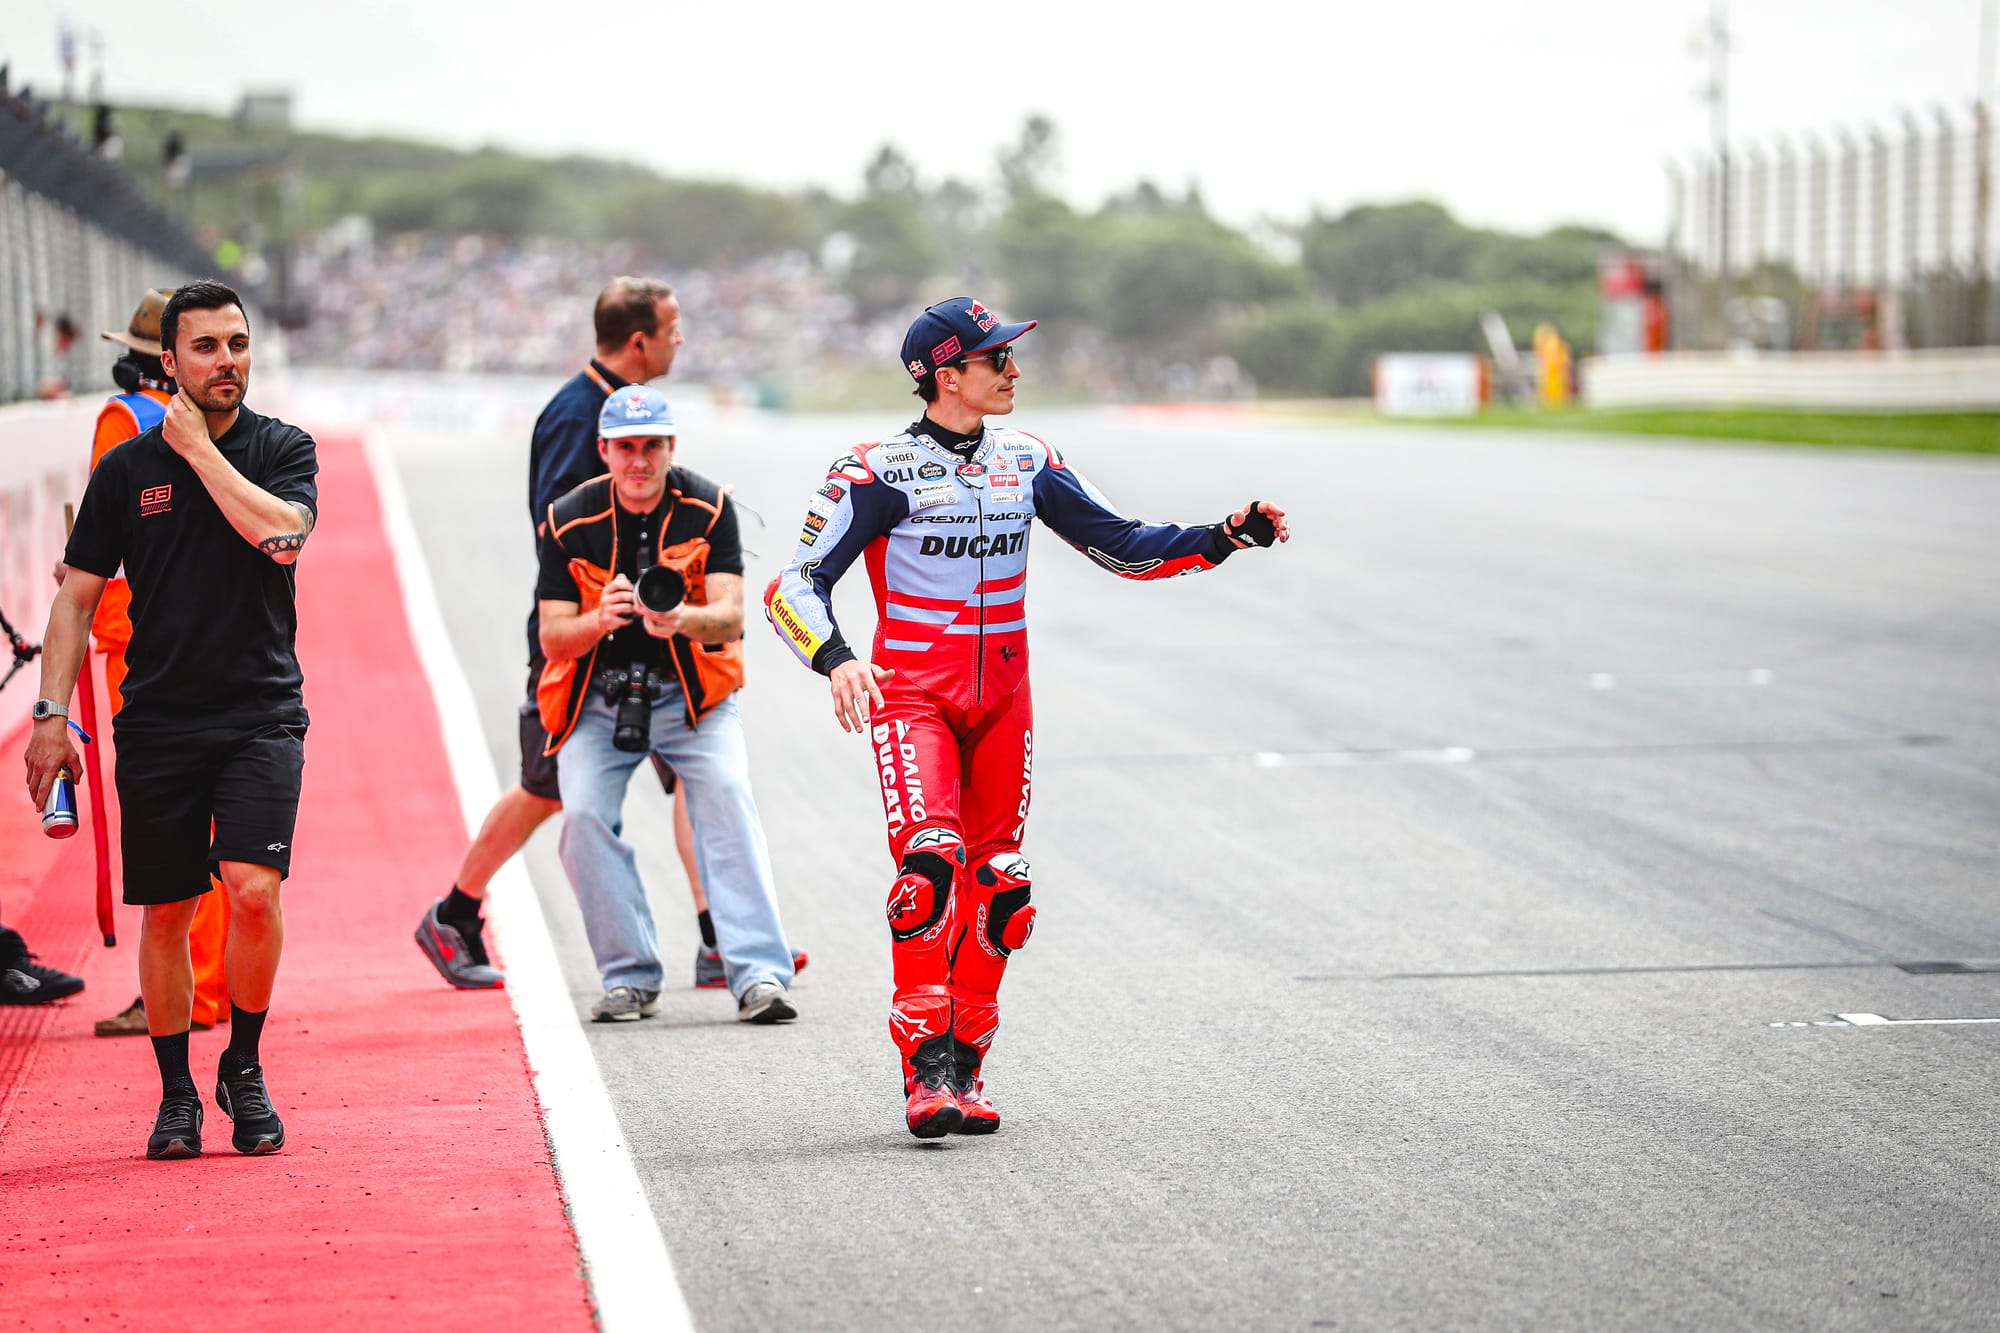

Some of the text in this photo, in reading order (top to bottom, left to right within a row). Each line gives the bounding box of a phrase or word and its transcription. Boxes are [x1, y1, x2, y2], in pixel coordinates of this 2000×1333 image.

[931, 336, 961, 365] 93
[885, 452, 915, 464] SHOEI
[883, 467, 915, 484] OLI
[141, 485, 172, 506] 93
[919, 497, 945, 508] Allianz
[911, 511, 1034, 524] GRESINI RACING
[919, 530, 1025, 559] DUCATI
[773, 598, 812, 648] Antangin
[873, 722, 906, 839] DUCATI
[899, 743, 927, 823] DAIKO
